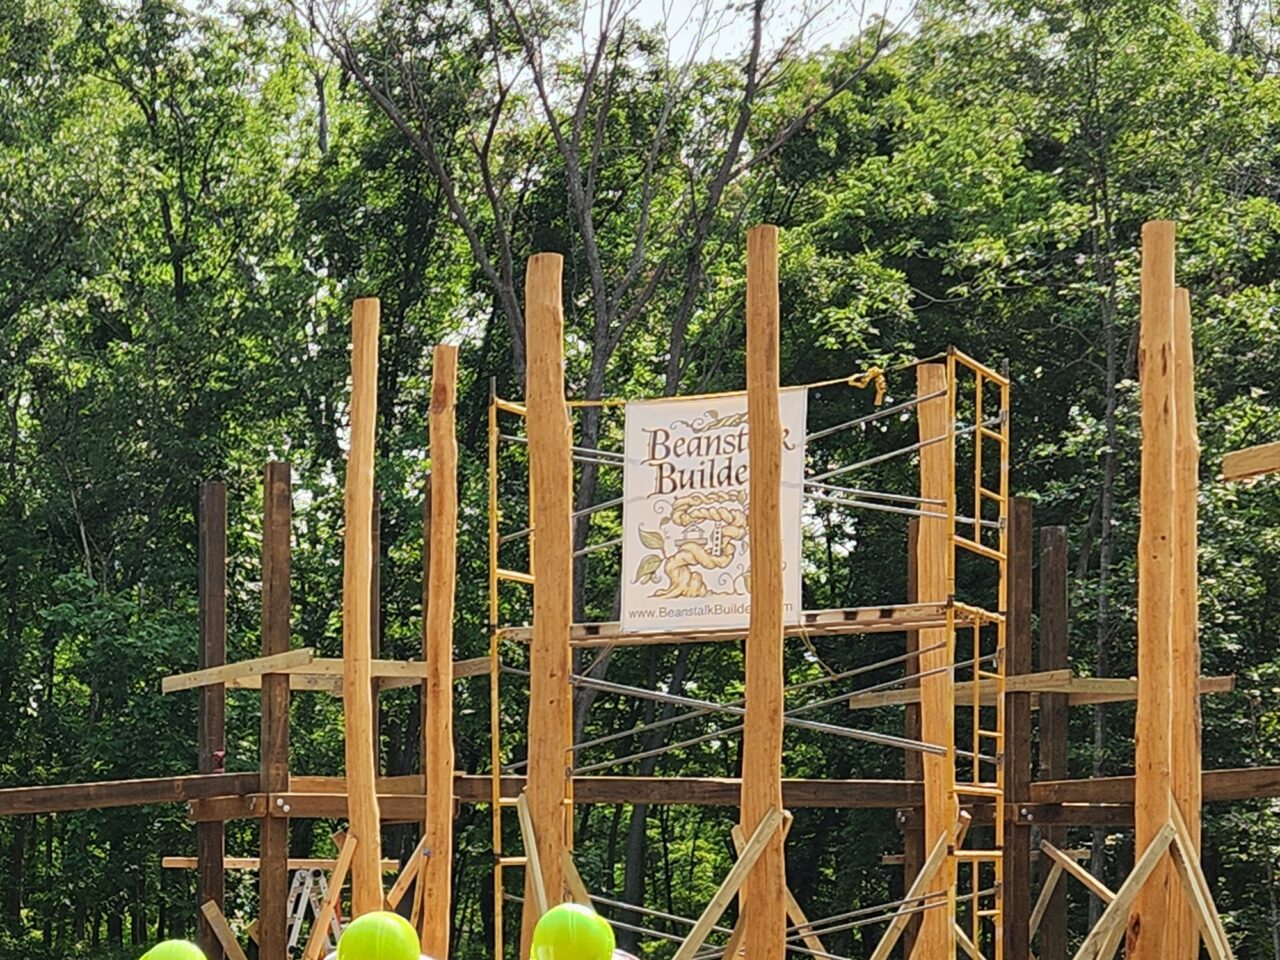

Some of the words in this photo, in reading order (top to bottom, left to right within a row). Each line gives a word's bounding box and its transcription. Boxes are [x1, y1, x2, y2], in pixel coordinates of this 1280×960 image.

[640, 427, 796, 465] Beanstk
[647, 457, 749, 498] Builde
[628, 602, 793, 619] www.BeanstalkBuildem
